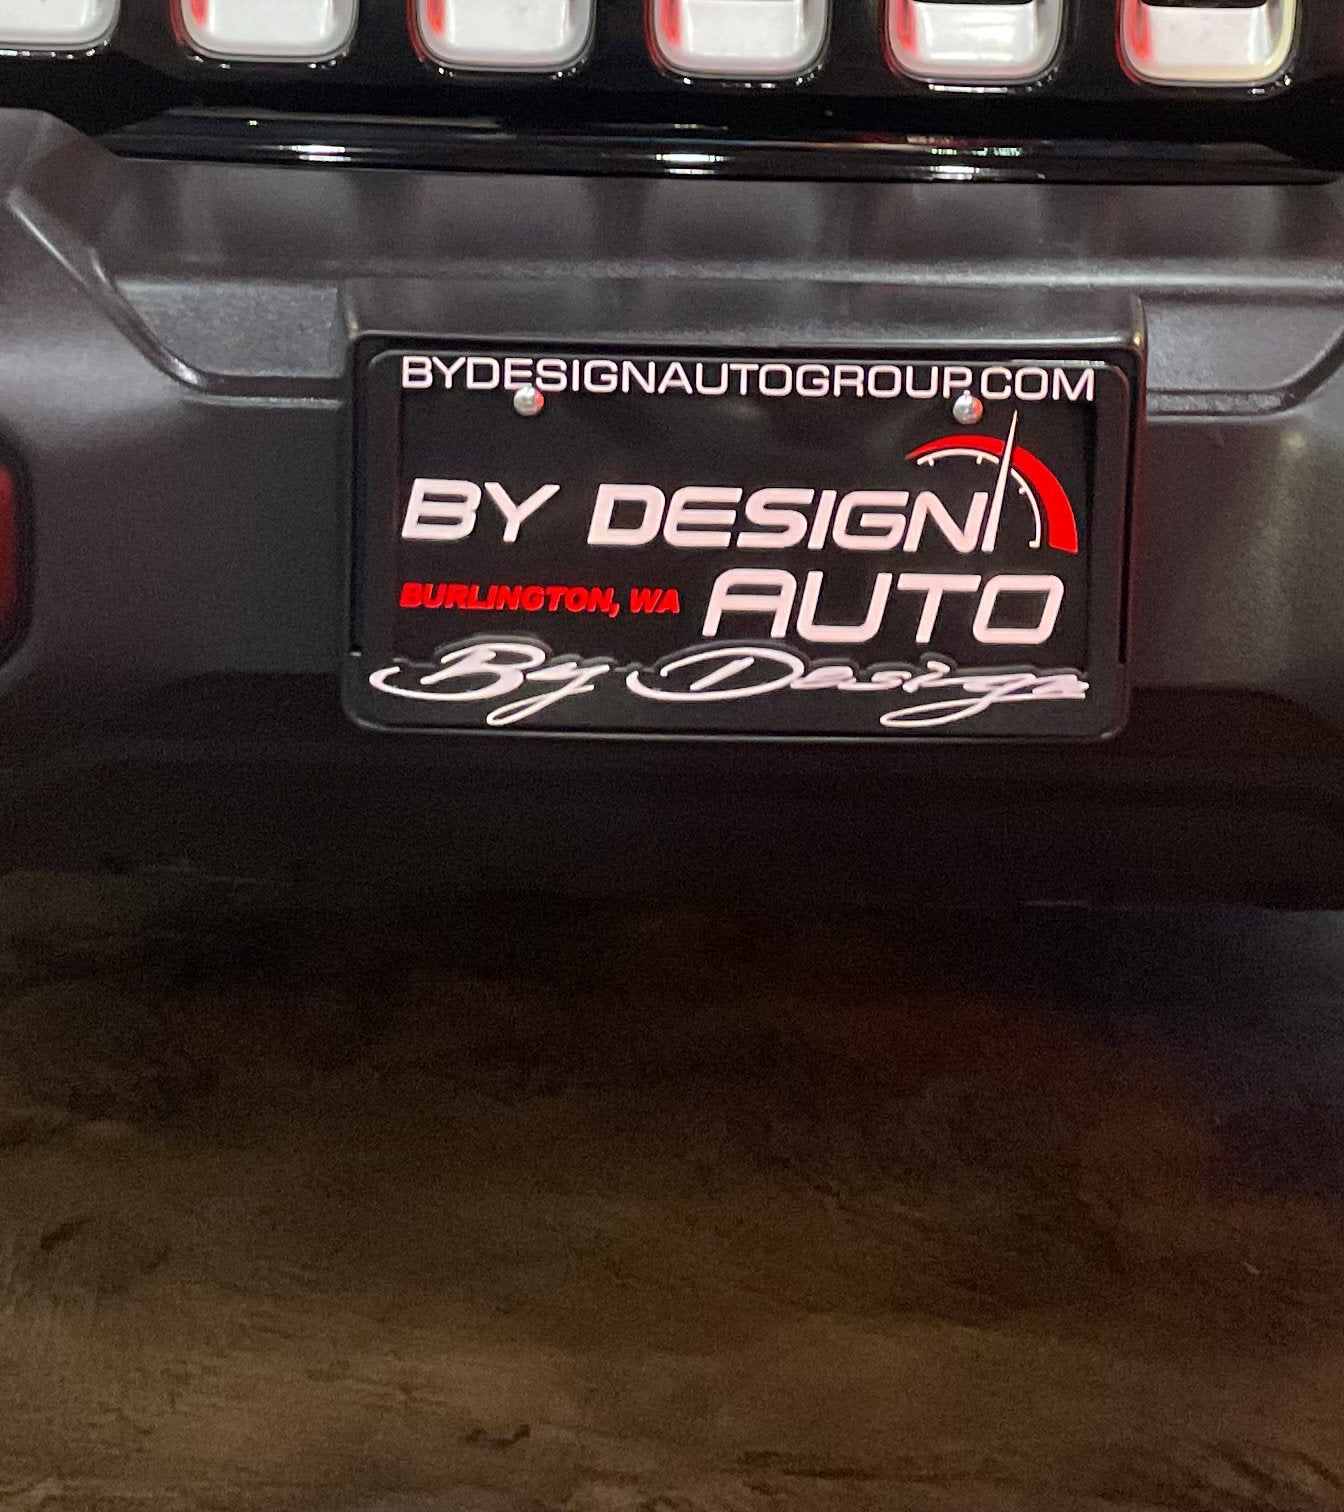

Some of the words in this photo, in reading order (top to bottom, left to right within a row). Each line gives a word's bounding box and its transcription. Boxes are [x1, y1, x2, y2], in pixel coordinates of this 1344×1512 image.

[401, 355, 1096, 402] BYDESIGNAUTOGROUP.COM
[401, 477, 561, 544] BY
[587, 483, 991, 553] DESIGN
[399, 582, 621, 619] BURLINGTON,
[629, 588, 680, 614] WA
[701, 567, 1065, 644] AUTO
[368, 641, 611, 727] By
[625, 645, 1091, 728] Design
